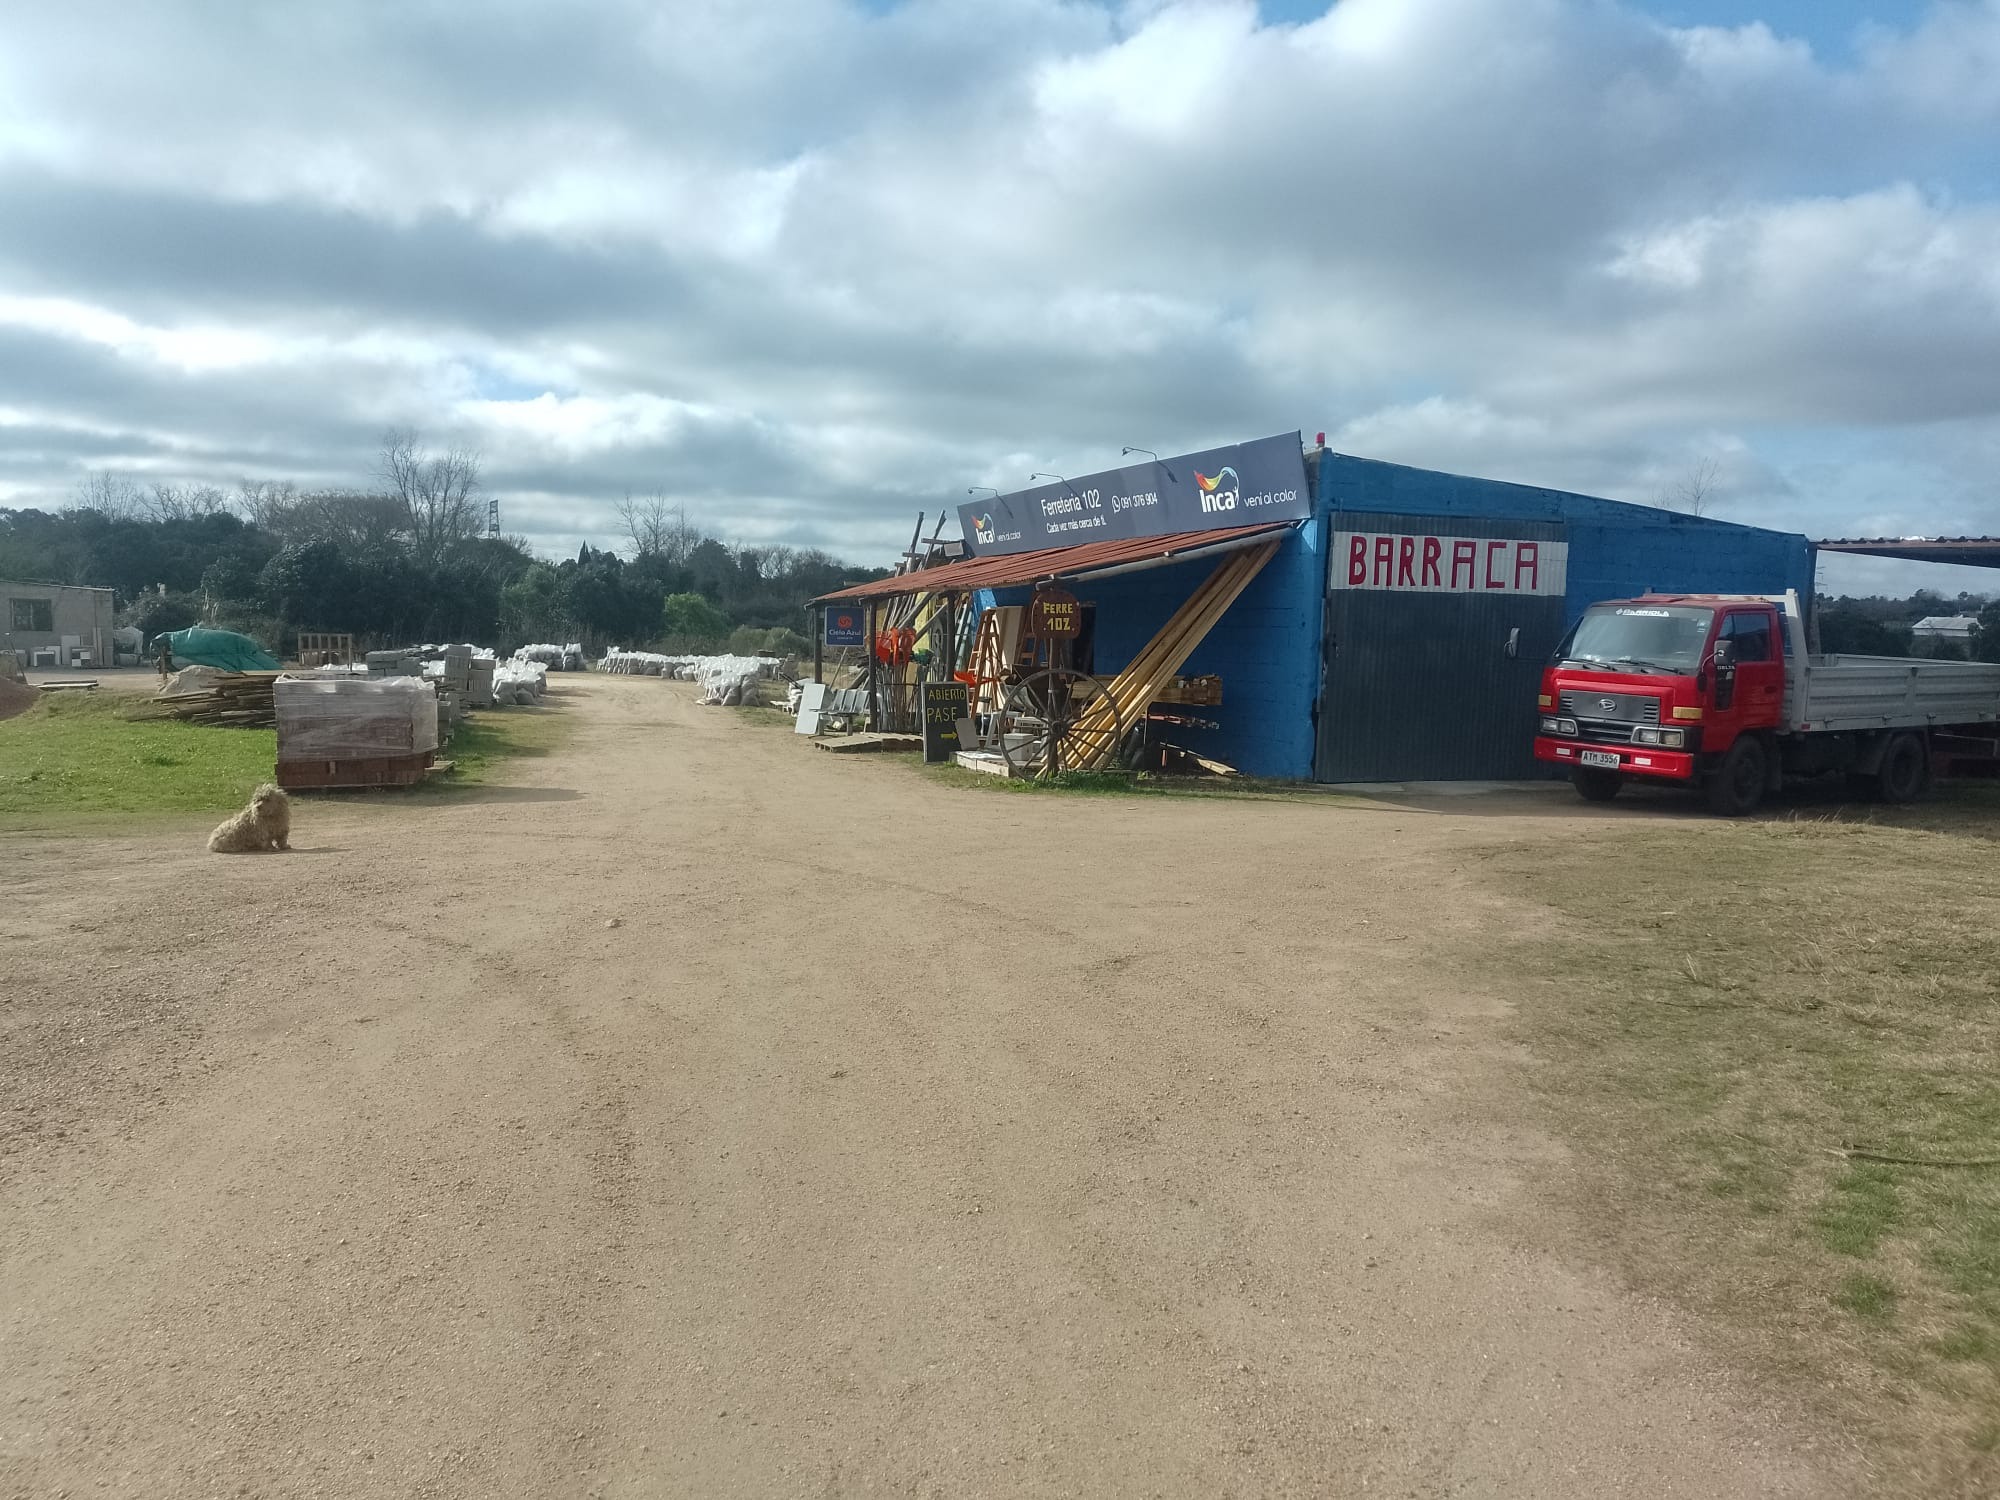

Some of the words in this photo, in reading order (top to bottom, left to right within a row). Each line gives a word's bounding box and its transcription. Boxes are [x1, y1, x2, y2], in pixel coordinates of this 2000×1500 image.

[1082, 488, 1102, 509] 102
[1199, 489, 1236, 513] Inca
[1263, 491, 1274, 504] al
[1273, 488, 1297, 503] color
[975, 527, 995, 545] Inca
[1348, 535, 1539, 590] BARRACA
[1043, 602, 1074, 614] FERRE
[928, 688, 967, 700] ABIERTO
[926, 706, 958, 724] PASE
